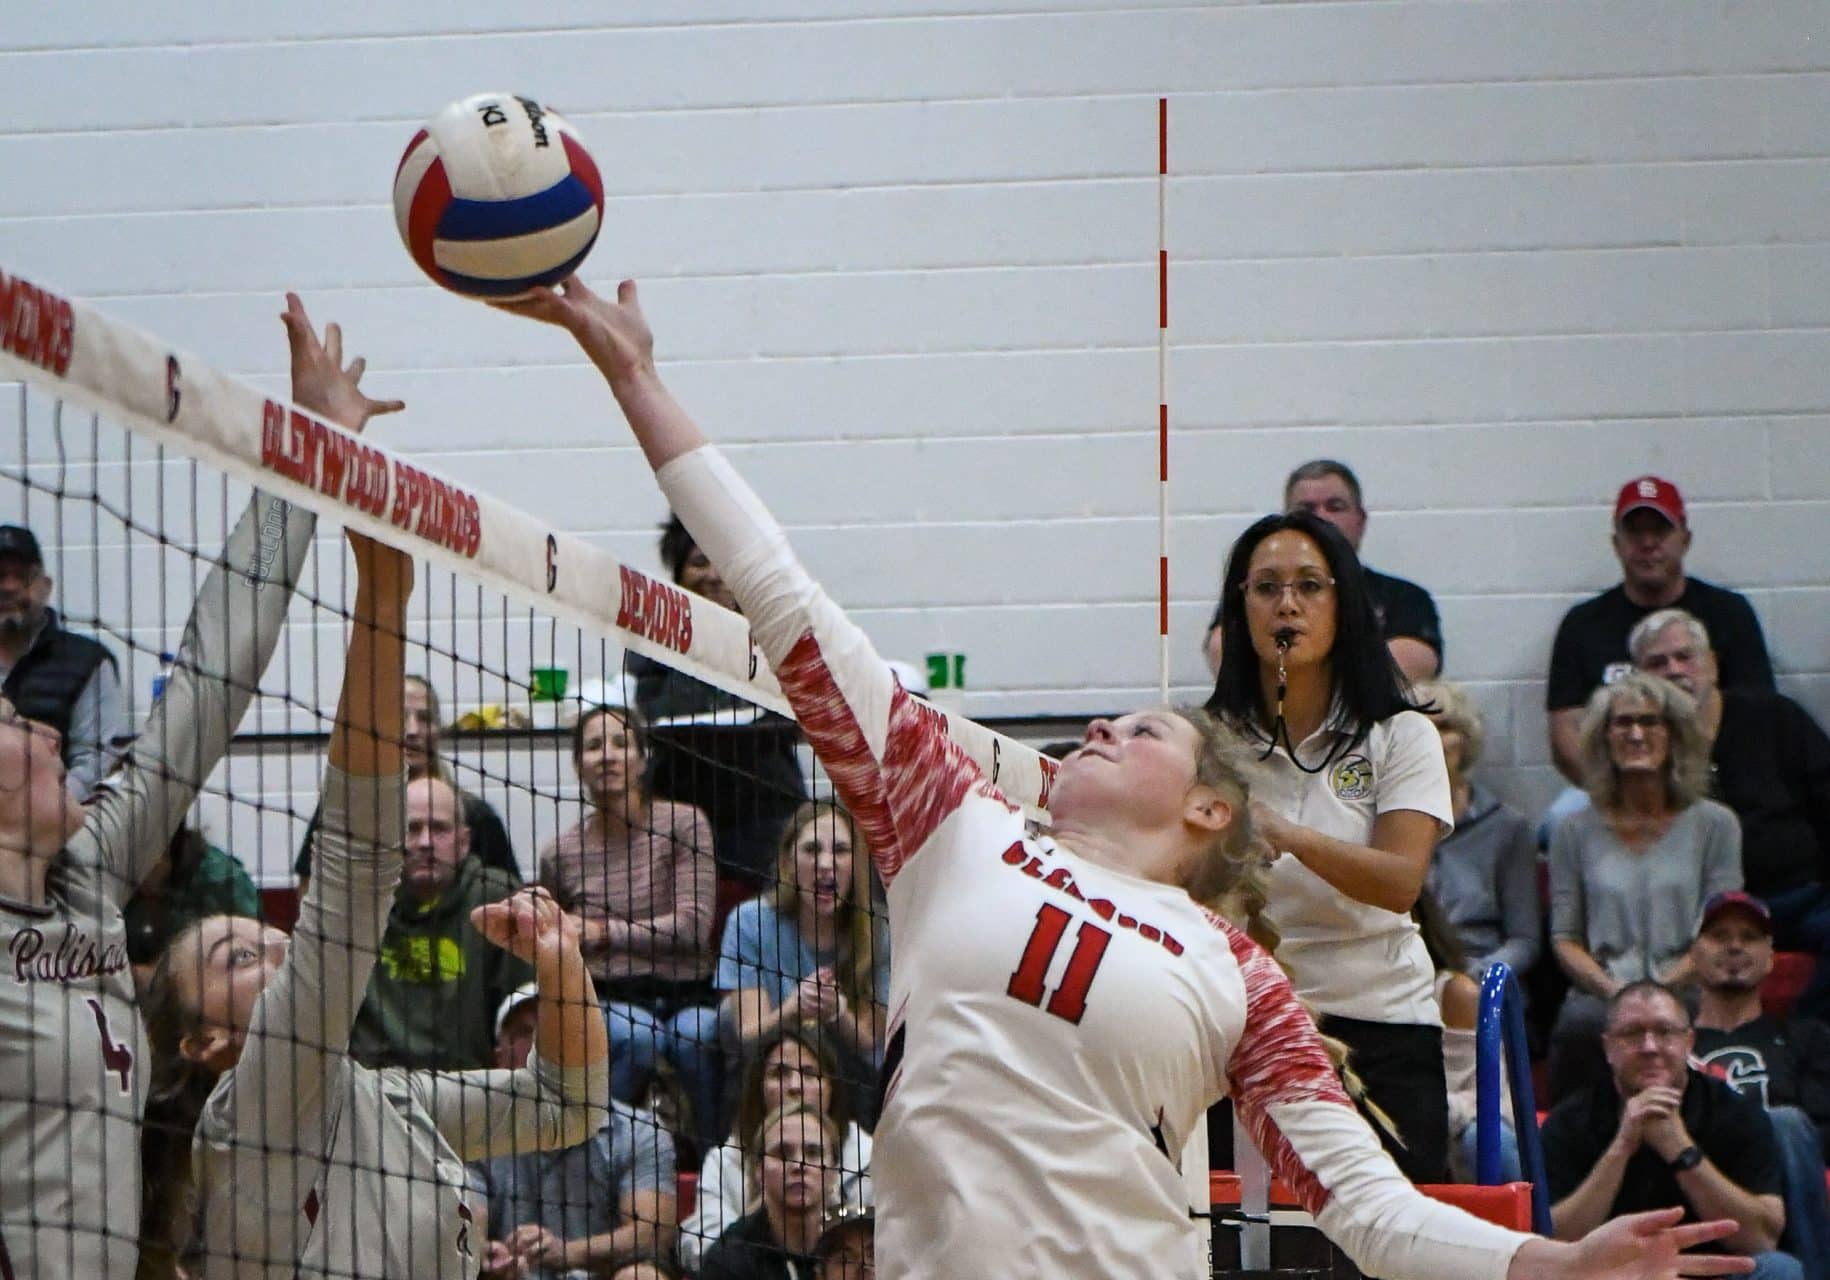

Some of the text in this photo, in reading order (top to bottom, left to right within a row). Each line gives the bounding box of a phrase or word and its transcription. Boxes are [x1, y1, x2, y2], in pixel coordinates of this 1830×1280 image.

[262, 398, 482, 559] GLENWOOD SPRINGS
[616, 563, 694, 655] DEMONS
[1005, 901, 1112, 1027] 11
